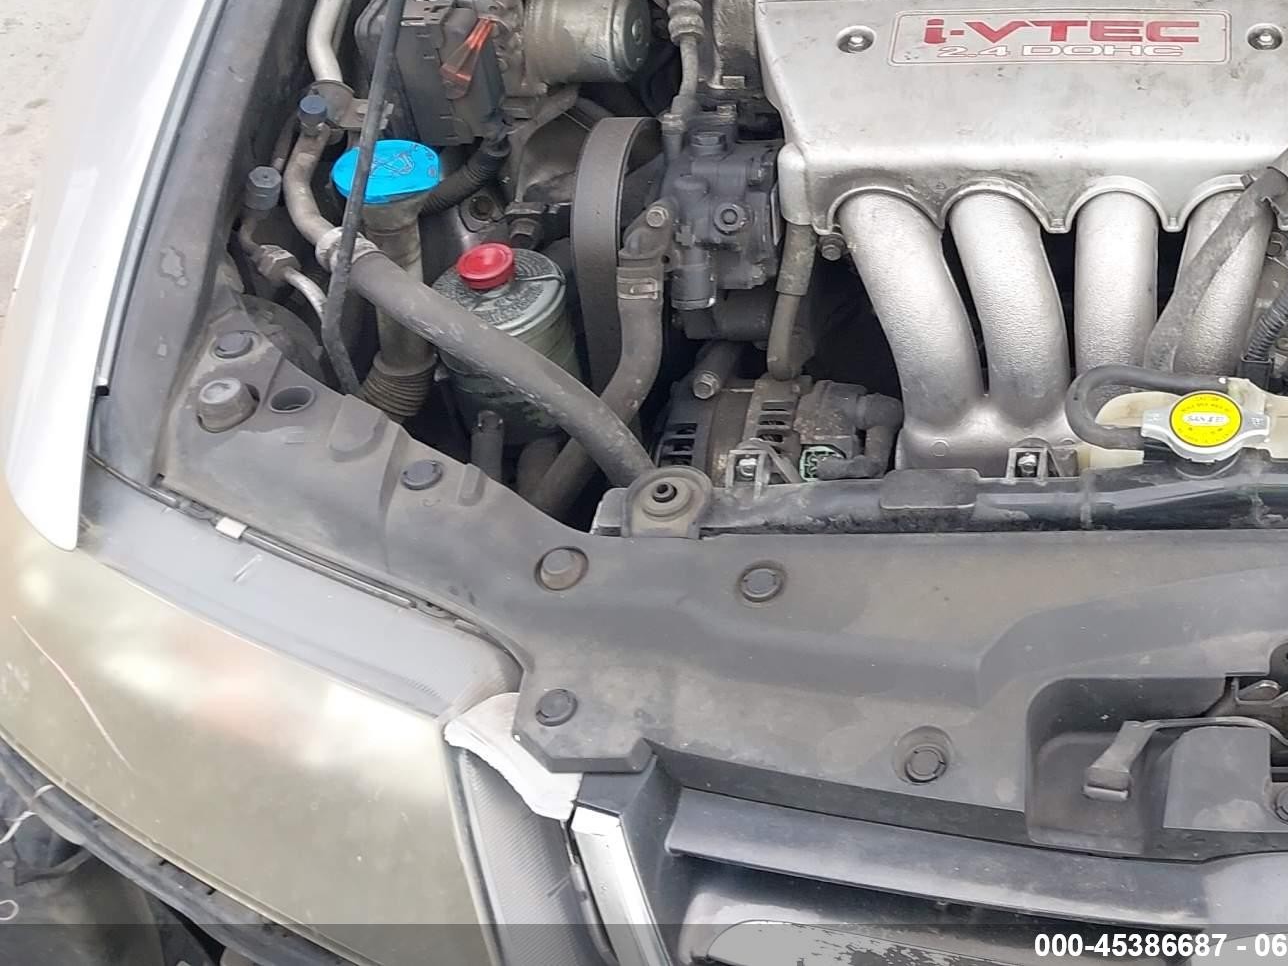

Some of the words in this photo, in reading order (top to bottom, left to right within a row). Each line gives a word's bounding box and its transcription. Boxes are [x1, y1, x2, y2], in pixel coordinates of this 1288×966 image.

[923, 18, 1200, 43] i-VTEC
[937, 44, 1011, 58] 2.4
[1021, 43, 1184, 58] DOHC
